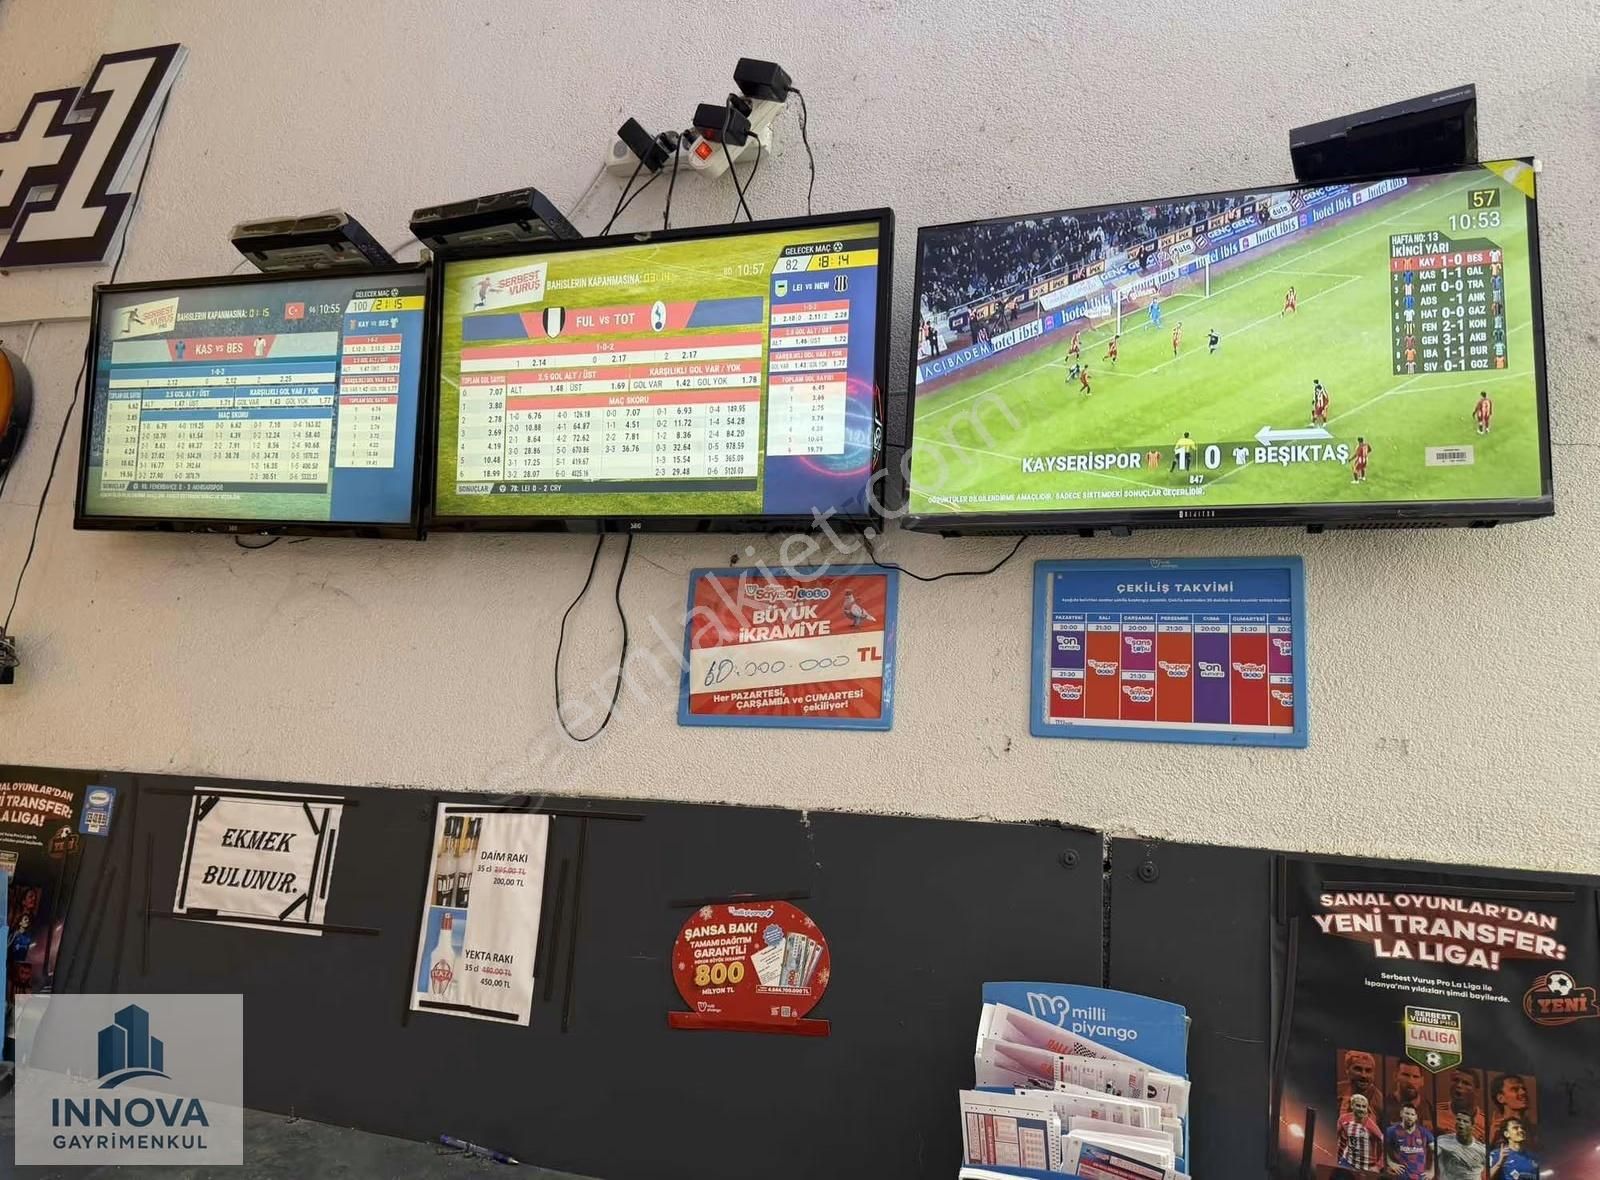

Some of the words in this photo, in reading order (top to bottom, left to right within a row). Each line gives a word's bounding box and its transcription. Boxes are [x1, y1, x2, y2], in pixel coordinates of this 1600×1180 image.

[1473, 190, 1496, 208] 57
[1449, 211, 1501, 231] 10:53
[1392, 234, 1413, 245] HAFTA
[1414, 234, 1426, 244] NO:
[1428, 232, 1439, 242] 13
[785, 244, 814, 256] GELECEK
[1392, 244, 1423, 258] İKİNCİ
[1426, 242, 1449, 254] YARI
[785, 258, 798, 271] 82
[818, 255, 849, 268] 18:14
[1419, 258, 1436, 268] KAY
[1441, 253, 1463, 266] 1-0
[738, 263, 766, 276] 10:57
[1420, 271, 1436, 280] KAS
[1441, 267, 1462, 279] 1-1
[1467, 266, 1484, 276] GAL
[498, 270, 540, 288] SERBEST
[792, 282, 803, 292] LEI
[814, 281, 830, 290] NEW
[1420, 284, 1437, 293] ANT
[1441, 280, 1464, 291] 0-0
[1467, 280, 1484, 290] TRA
[353, 300, 368, 312] 100
[376, 298, 402, 310] 21:15
[1420, 297, 1437, 306] ADS
[1468, 292, 1486, 302] ANK
[319, 304, 340, 314] 10:55
[1421, 310, 1438, 319] HAT
[1442, 306, 1465, 318] 0-0
[1468, 306, 1486, 316] GAZ
[576, 316, 594, 328] FUL
[614, 312, 634, 326] TOT
[1422, 322, 1438, 332] FEN
[1442, 320, 1464, 331] 2-1
[1469, 318, 1487, 329] KON
[1422, 336, 1439, 345] GEN
[1443, 332, 1465, 344] 3-1
[1470, 332, 1487, 342] AKB
[195, 342, 213, 354] KAS
[226, 342, 243, 353] BES
[682, 351, 697, 359] 2.17
[1423, 348, 1438, 358] IBA
[1444, 346, 1465, 358] 1-1
[1470, 345, 1488, 355] BUR
[612, 355, 626, 363] 2.17
[924, 345, 991, 378] ACIBADEM
[1423, 362, 1438, 371] SIV
[1444, 359, 1466, 371] 0-1
[1471, 358, 1489, 368] GOZ
[550, 384, 564, 392] 1.48
[611, 382, 626, 390] 1.69
[650, 380, 663, 388] VAR
[676, 379, 691, 387] 1.42
[698, 378, 711, 386] GOL
[712, 377, 728, 385] YOK
[510, 386, 522, 394] ALT
[1022, 451, 1140, 473] KAYSERİSPOR
[1176, 447, 1186, 470] 1
[1204, 444, 1221, 470] 0
[1189, 474, 1204, 484] 847
[1116, 580, 1170, 594] ÇEKİLİŞ
[1174, 580, 1234, 593] TAKVİMİ
[753, 602, 818, 624] BÜYÜK
[739, 620, 830, 643] İKRAMİYE
[857, 646, 882, 662] TL
[714, 695, 730, 703] Her
[736, 696, 790, 710] ÇARŞAMBA
[792, 697, 803, 705] ve
[803, 700, 849, 714] çekiliyor!
[12, 782, 74, 802] OYUNLAR'DAN
[7, 795, 74, 819] TRANSFER:
[12, 810, 46, 827] LIGA!
[220, 828, 297, 853] EKMEK
[507, 852, 528, 863] RAKI
[476, 864, 485, 872] 35
[202, 864, 298, 894] BULUNUR.
[493, 878, 514, 886] 200,00
[1320, 893, 1391, 908] SANAL
[1394, 893, 1558, 931] OYUNLAR'DAN
[684, 924, 726, 942] ŞANSA
[728, 922, 758, 934] BAK!
[1312, 908, 1384, 934] YENİ
[1388, 914, 1567, 960] TRANSFER:
[690, 939, 720, 949] TAMAMI
[720, 936, 752, 946] DAĞITIM
[465, 948, 492, 962] YEKTA
[492, 953, 514, 964] RAKI
[694, 944, 747, 959] GARANTİLİ
[1373, 938, 1414, 960] LA
[1418, 941, 1500, 971] LIGA!
[464, 964, 472, 972] 35
[694, 961, 745, 987] 800
[480, 978, 502, 988] 450,00
[504, 980, 511, 989] TL
[1380, 972, 1412, 983] Serbest
[1412, 976, 1436, 986] Vuruş
[1436, 980, 1451, 988] Pro
[1463, 982, 1482, 992] Liga
[1482, 983, 1493, 992] ile
[702, 987, 726, 996] MİLYON
[1446, 989, 1469, 998] şimdi
[1469, 992, 1511, 1003] bayilerde.
[1536, 992, 1587, 1014] YENİ
[1072, 1006, 1106, 1022] milli
[1414, 1010, 1453, 1020] SERBEST
[1072, 1020, 1138, 1042] piyango
[1410, 1028, 1457, 1045] LALIGA
